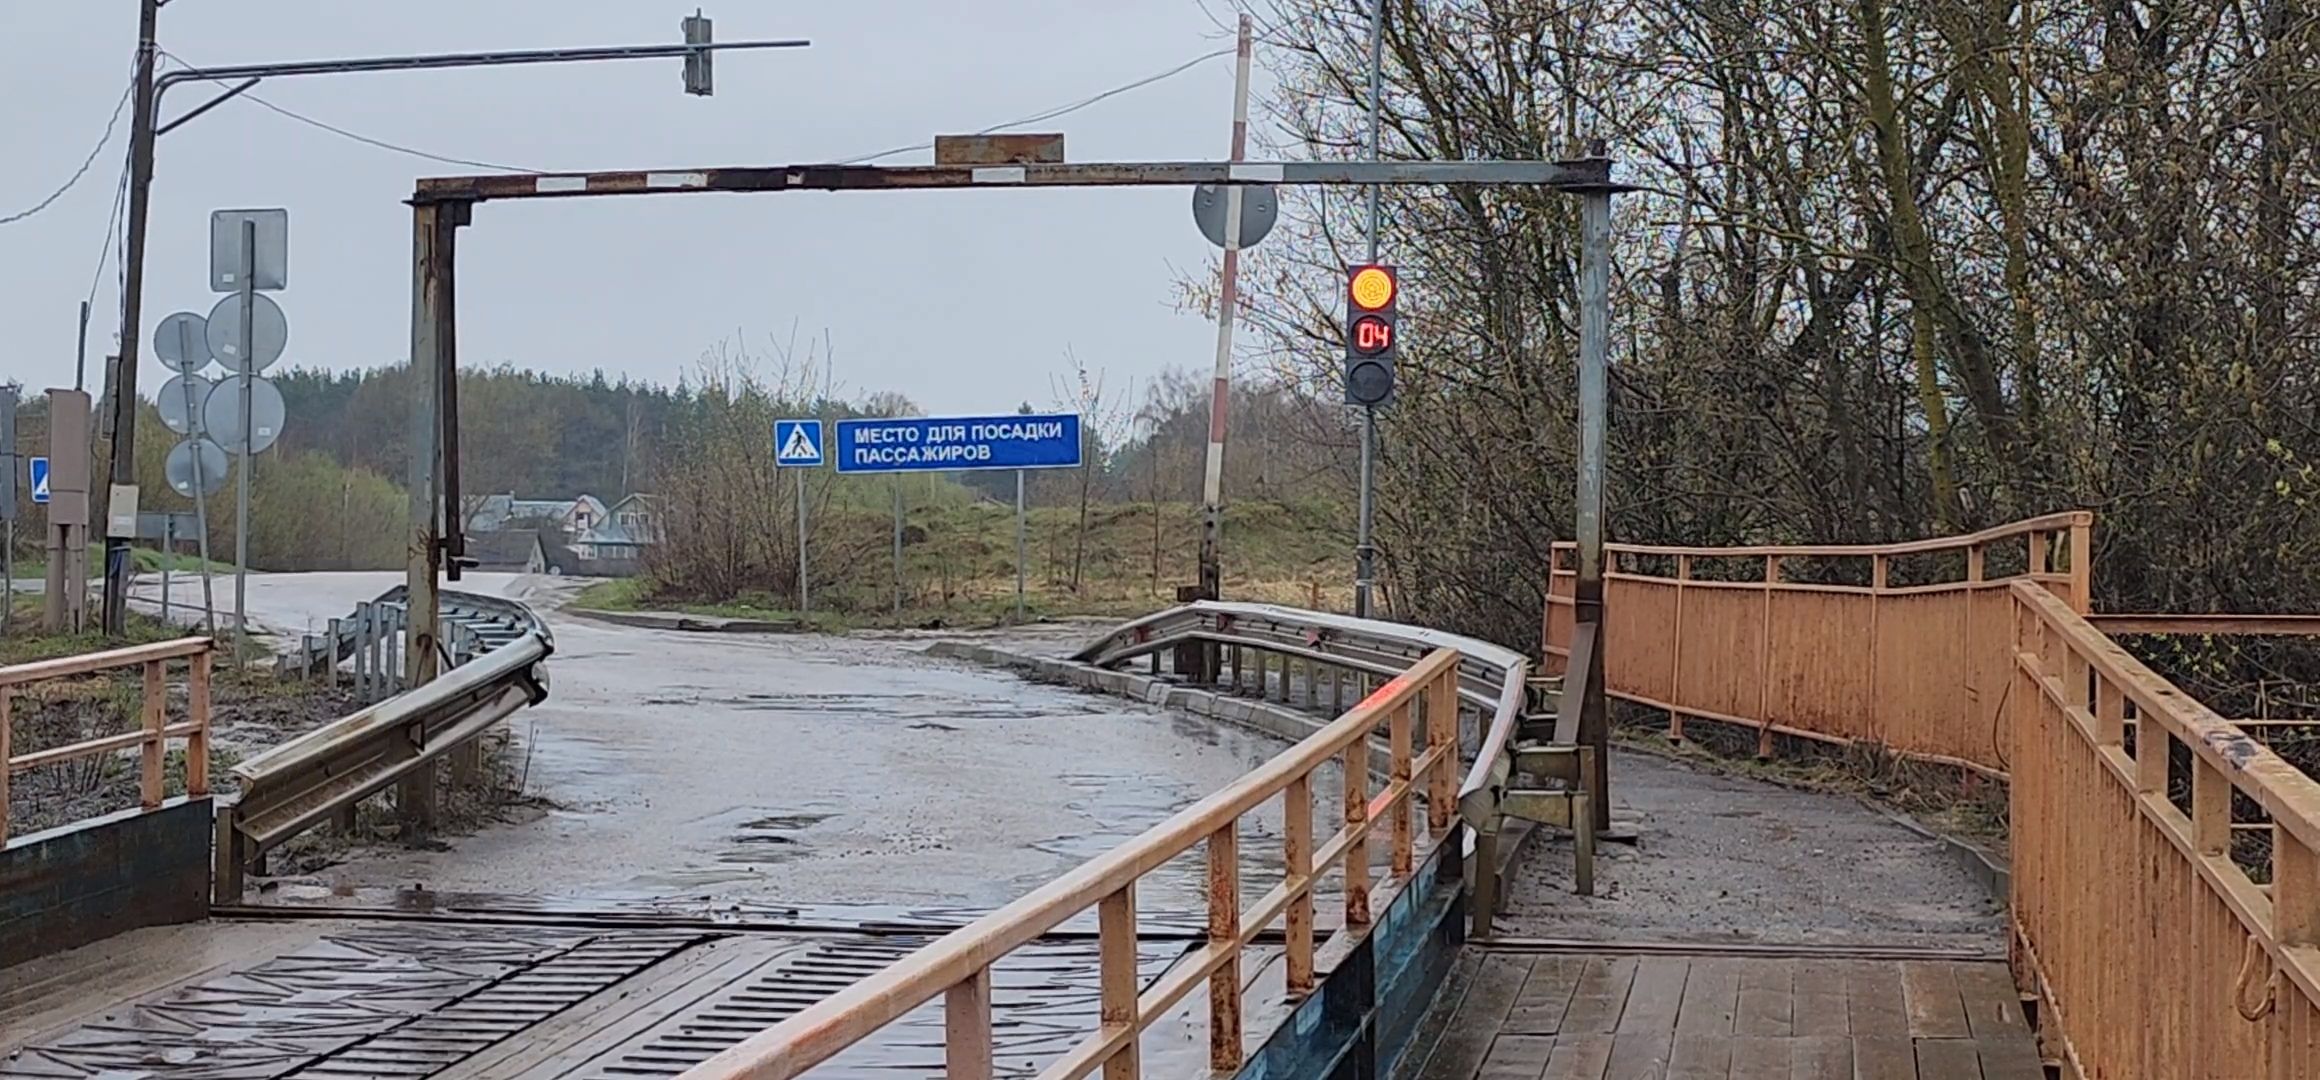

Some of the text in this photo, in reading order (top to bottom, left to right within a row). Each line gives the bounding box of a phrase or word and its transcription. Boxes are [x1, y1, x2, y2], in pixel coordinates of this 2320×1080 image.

[1359, 323, 1388, 347] 04
[854, 422, 1062, 444] МЕСТО ДЛЯ ПОСАДКИ
[854, 445, 991, 464] ПАССАЖИРОВ
